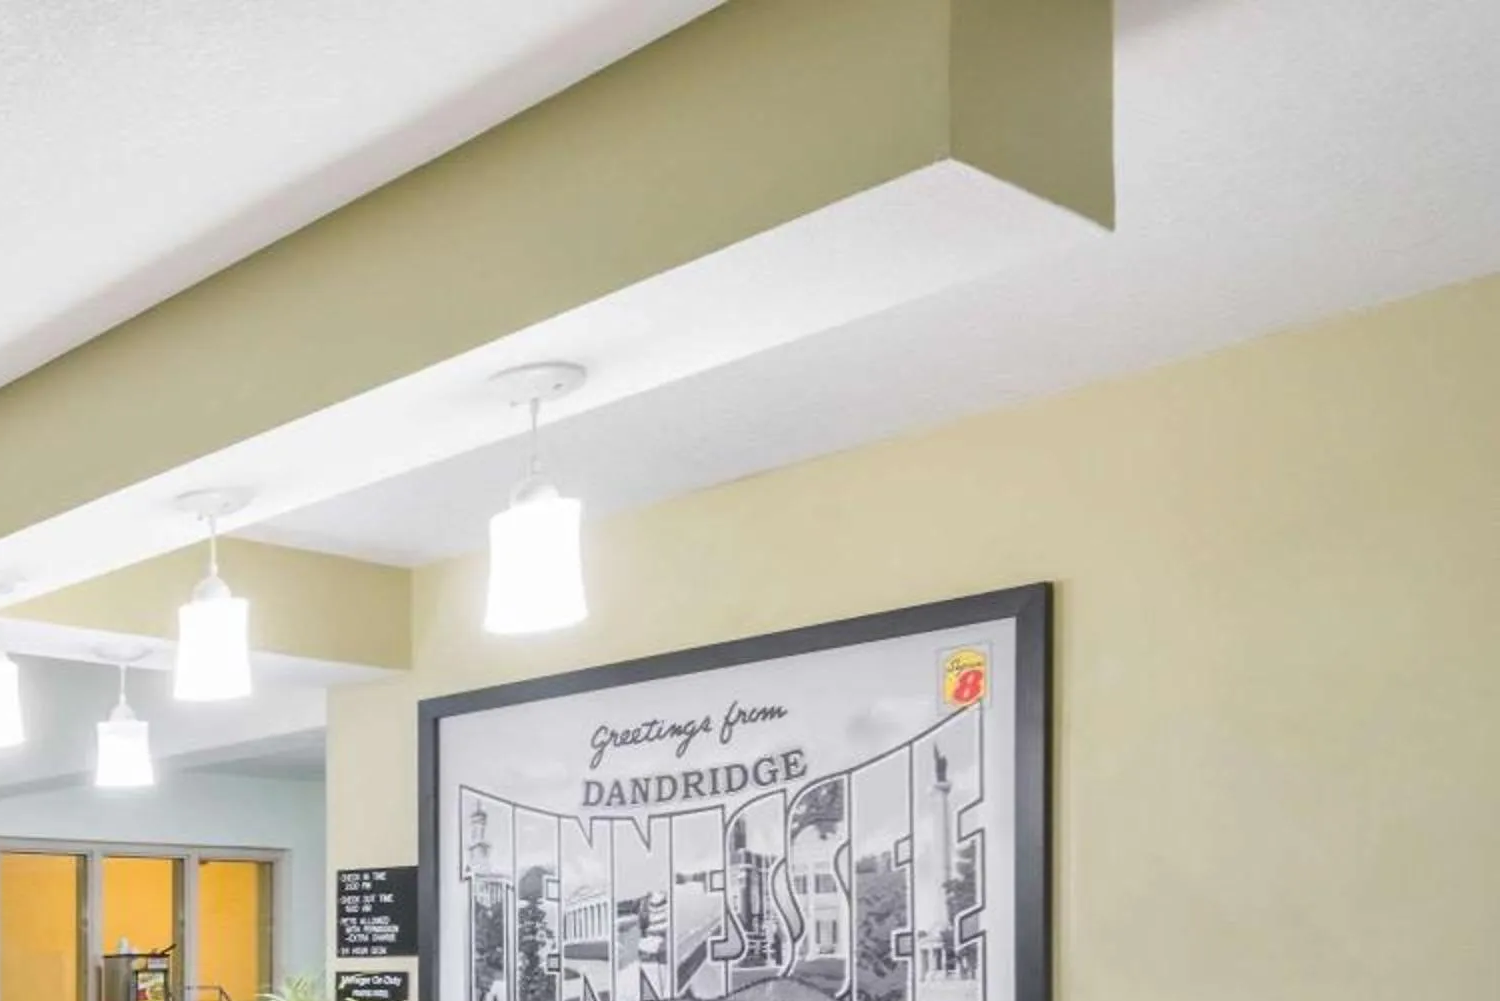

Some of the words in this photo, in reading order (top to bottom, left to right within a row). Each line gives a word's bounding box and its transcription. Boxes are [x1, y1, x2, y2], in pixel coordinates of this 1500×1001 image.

[954, 669, 984, 703] 8
[590, 716, 713, 770] Greetings
[719, 700, 789, 745] from
[582, 748, 808, 808] DANDRIDGE
